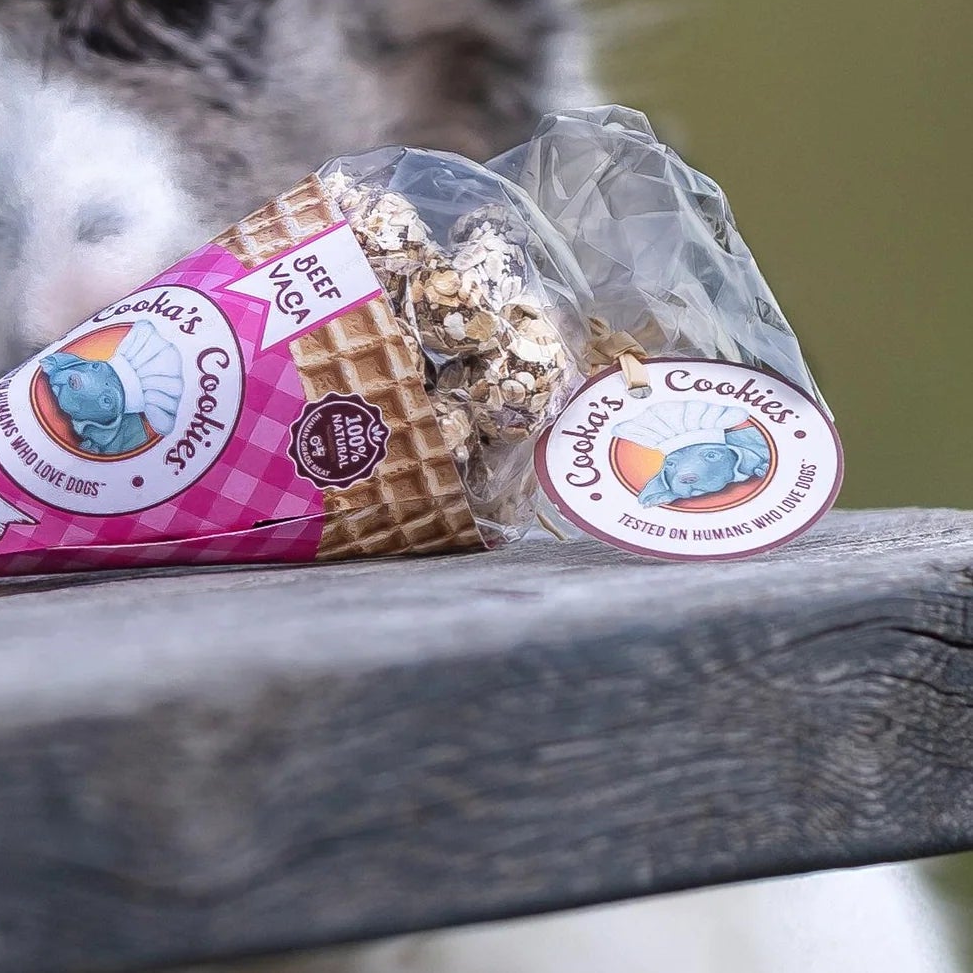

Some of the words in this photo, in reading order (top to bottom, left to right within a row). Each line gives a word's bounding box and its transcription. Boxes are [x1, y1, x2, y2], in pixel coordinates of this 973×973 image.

[268, 262, 311, 324] VACA
[293, 255, 342, 299] BEEF
[93, 291, 202, 334] Cooka's
[165, 347, 230, 470] Cookies
[332, 414, 349, 469] NATURAL
[345, 414, 368, 463] 100%
[561, 395, 624, 487] Cooka's
[664, 369, 794, 424] Cookies
[10, 435, 38, 466] WHO
[34, 459, 67, 487] LOVE
[310, 463, 331, 477] MEAT
[618, 512, 664, 538] TESTED
[669, 528, 688, 540] ON
[693, 522, 752, 541] HUMANS
[753, 507, 782, 530] WHO
[777, 488, 805, 514] LOVE
